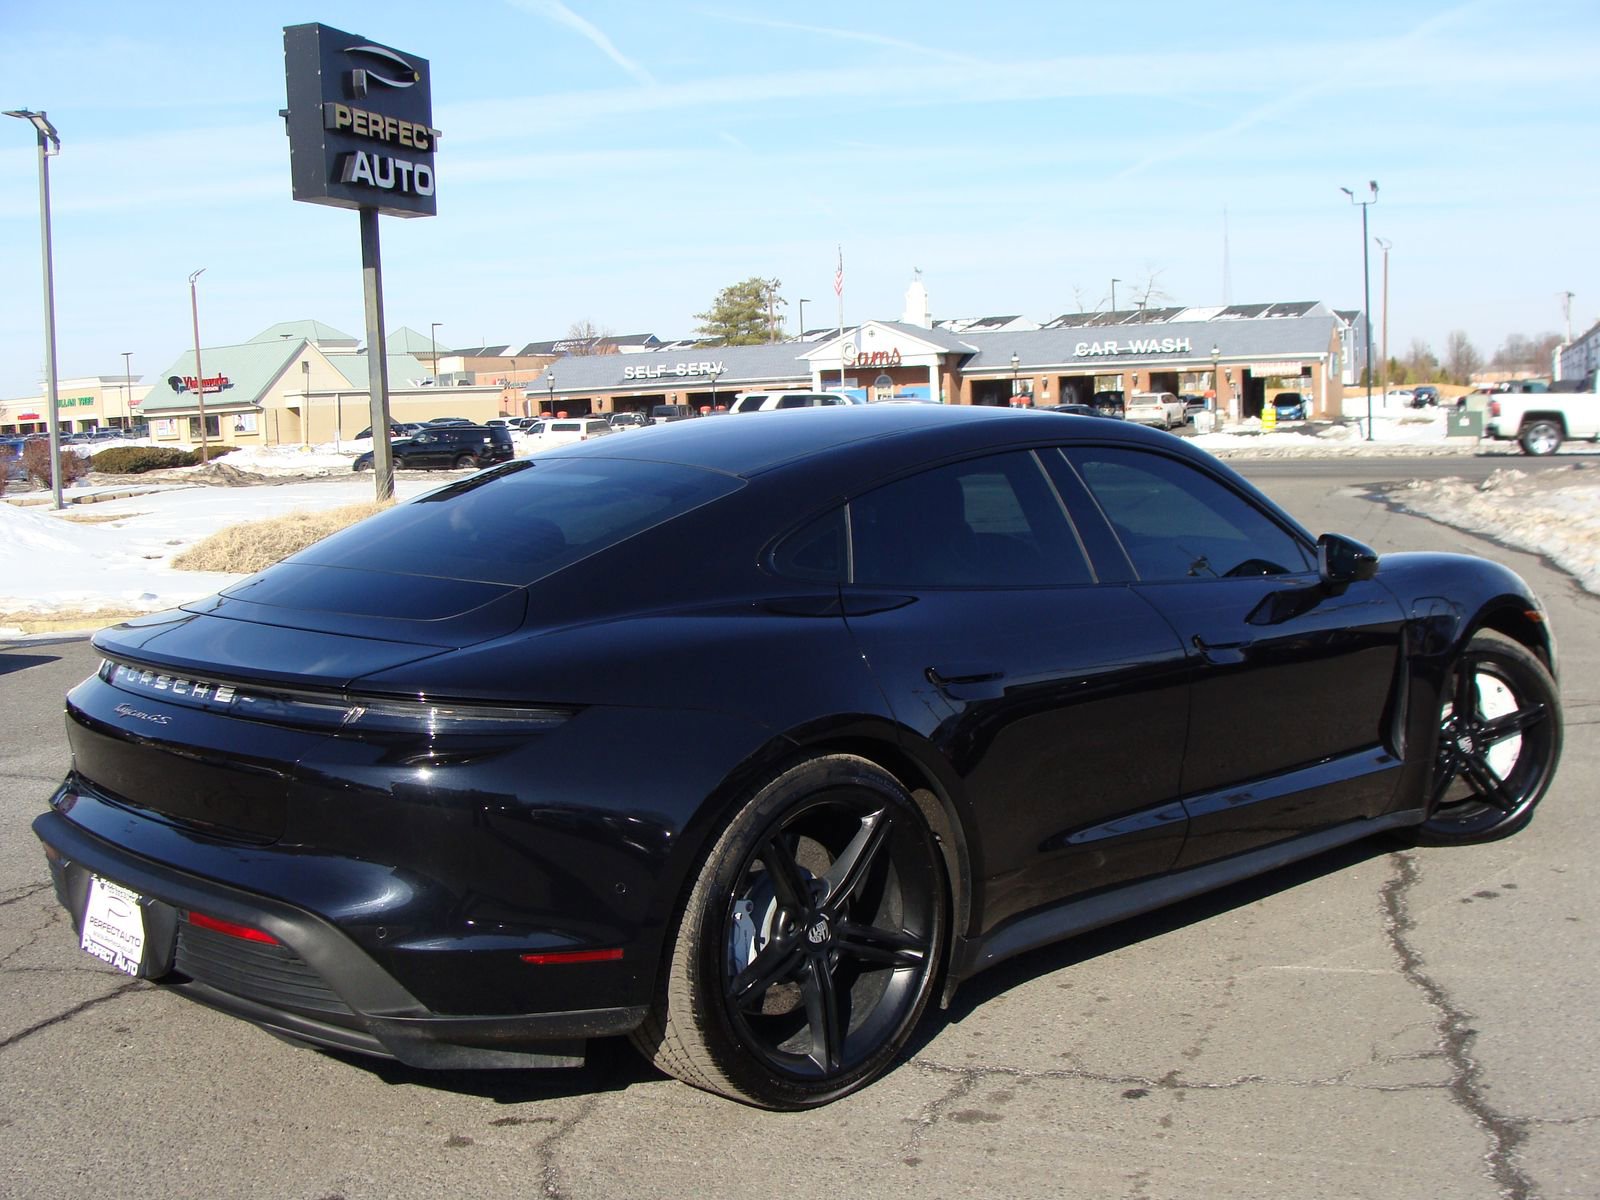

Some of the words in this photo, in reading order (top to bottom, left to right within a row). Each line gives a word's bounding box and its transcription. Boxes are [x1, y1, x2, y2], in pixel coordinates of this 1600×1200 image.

[331, 102, 442, 152] PERFECT
[345, 150, 435, 196] AUTO
[1074, 341, 1118, 357] CAR
[1128, 337, 1190, 354] WASH
[624, 364, 667, 379] SELF
[676, 360, 723, 376] SERV
[89, 916, 120, 937] PERFECT
[119, 930, 141, 948] AUTO
[113, 950, 138, 976] AUTO
